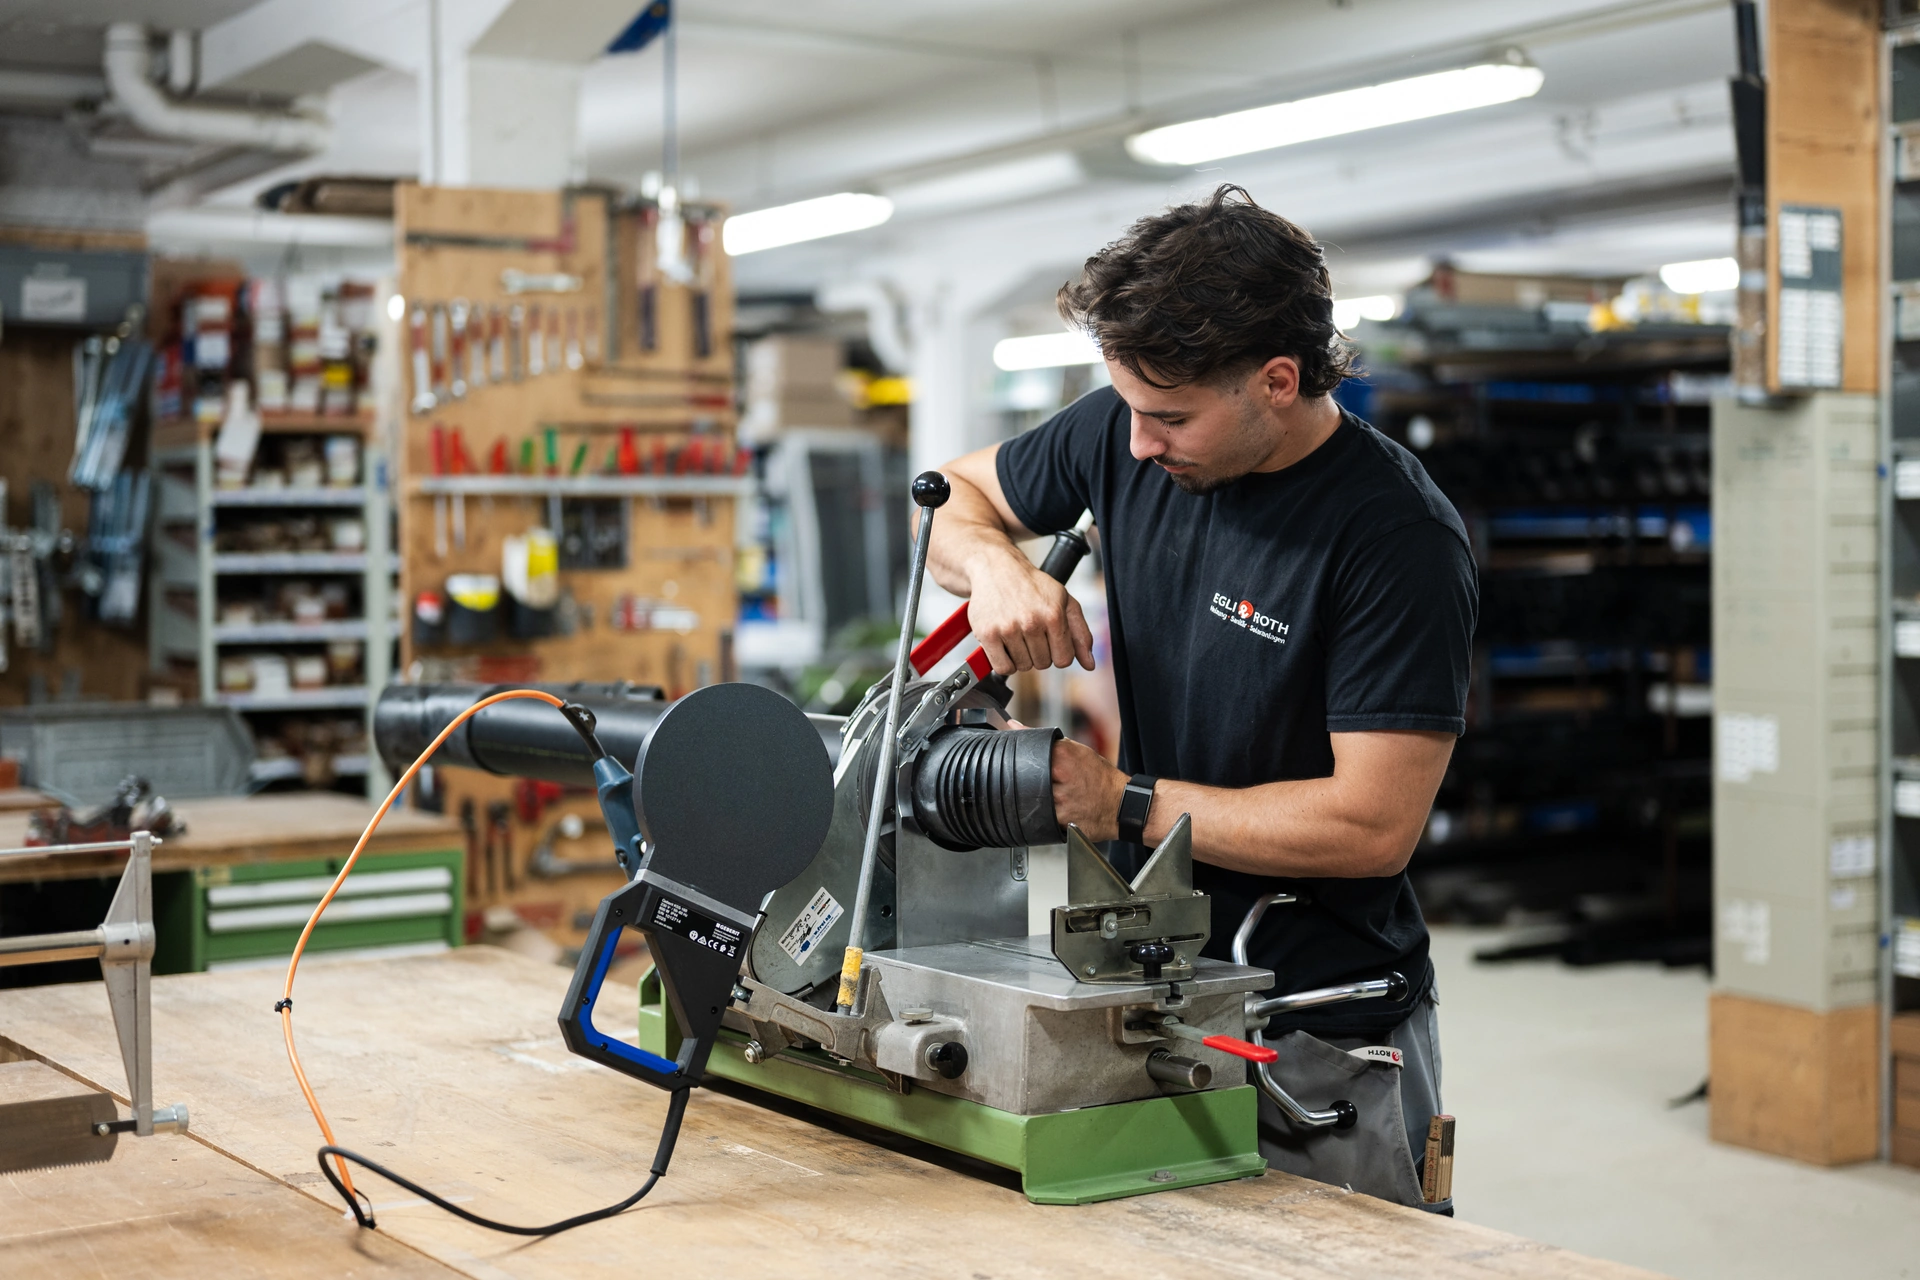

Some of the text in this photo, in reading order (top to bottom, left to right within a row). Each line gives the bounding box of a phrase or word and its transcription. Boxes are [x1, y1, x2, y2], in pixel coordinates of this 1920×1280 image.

[1213, 592, 1237, 613] EGLI
[1253, 611, 1289, 635] ROTH
[720, 925, 740, 936] GEBERIT
